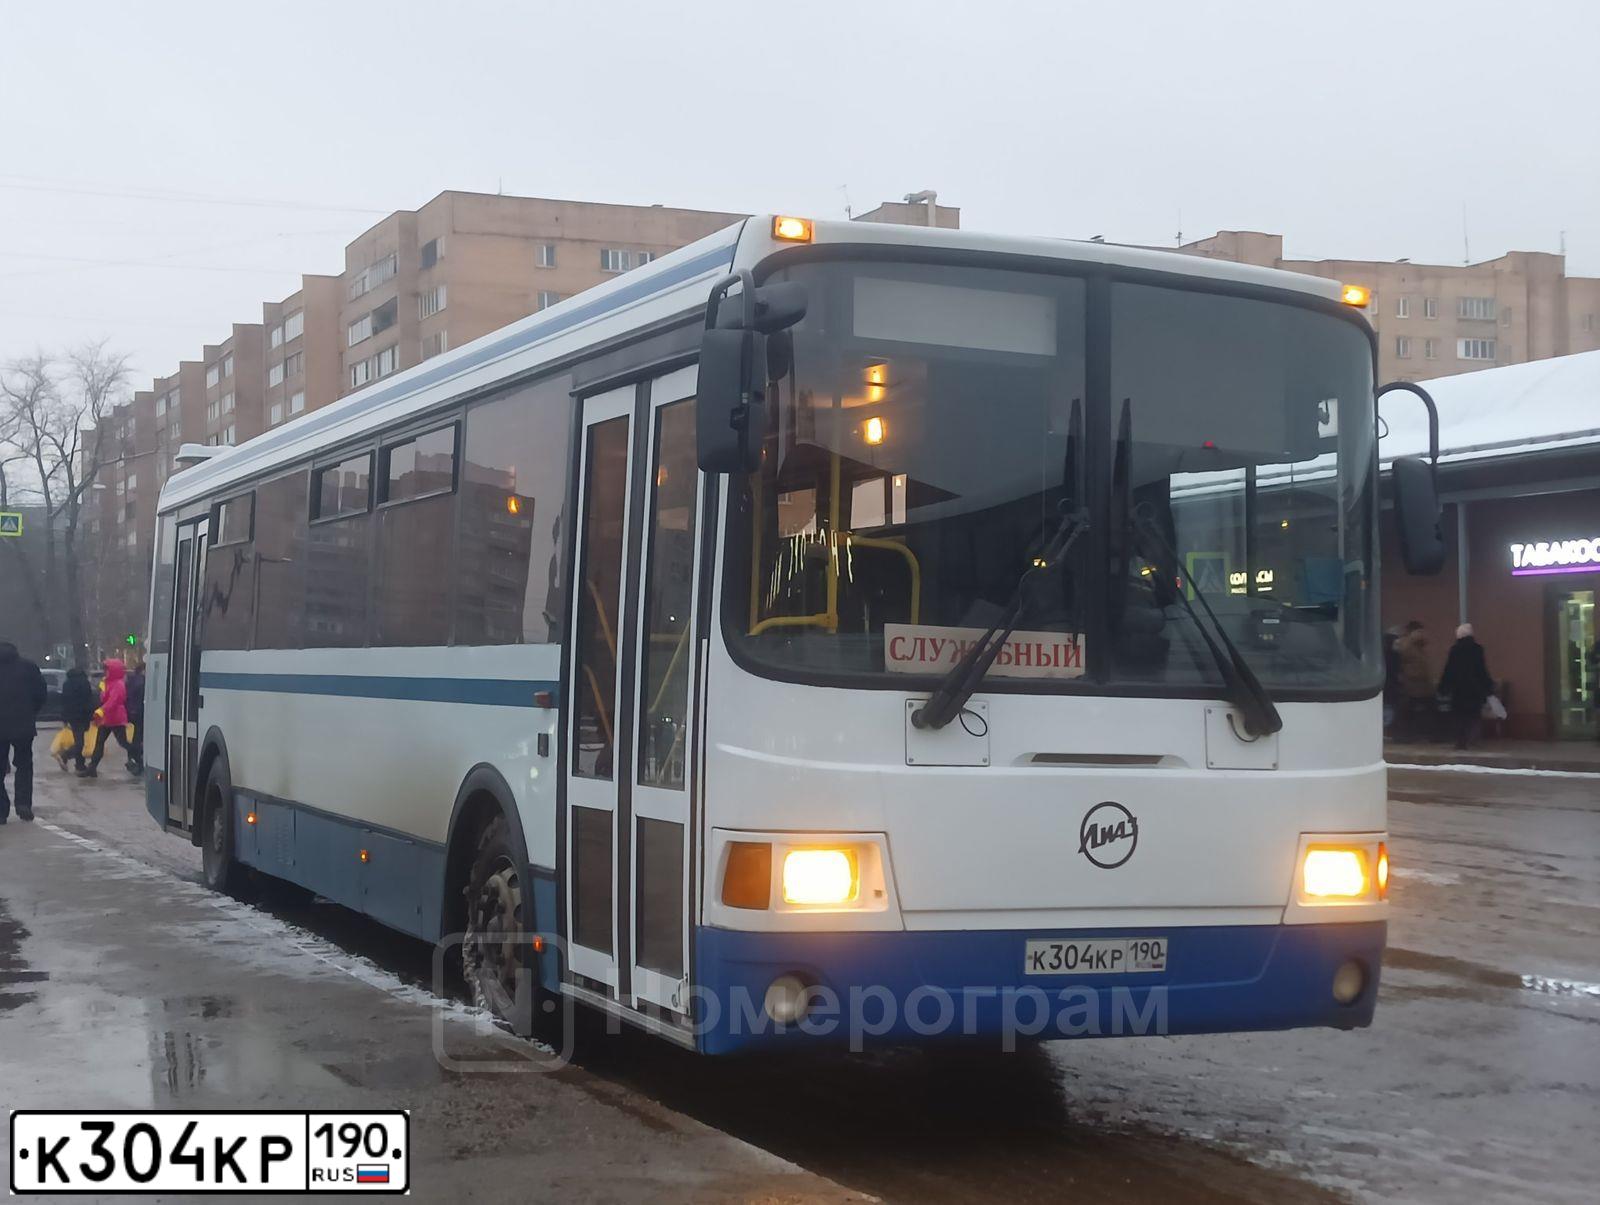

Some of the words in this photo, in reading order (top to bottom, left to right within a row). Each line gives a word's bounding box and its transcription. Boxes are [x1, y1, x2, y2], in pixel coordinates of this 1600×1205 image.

[889, 636, 1082, 668] СЛУЖБНЫЙ
[1032, 945, 1122, 970] К304КР
[1130, 941, 1161, 960] 190
